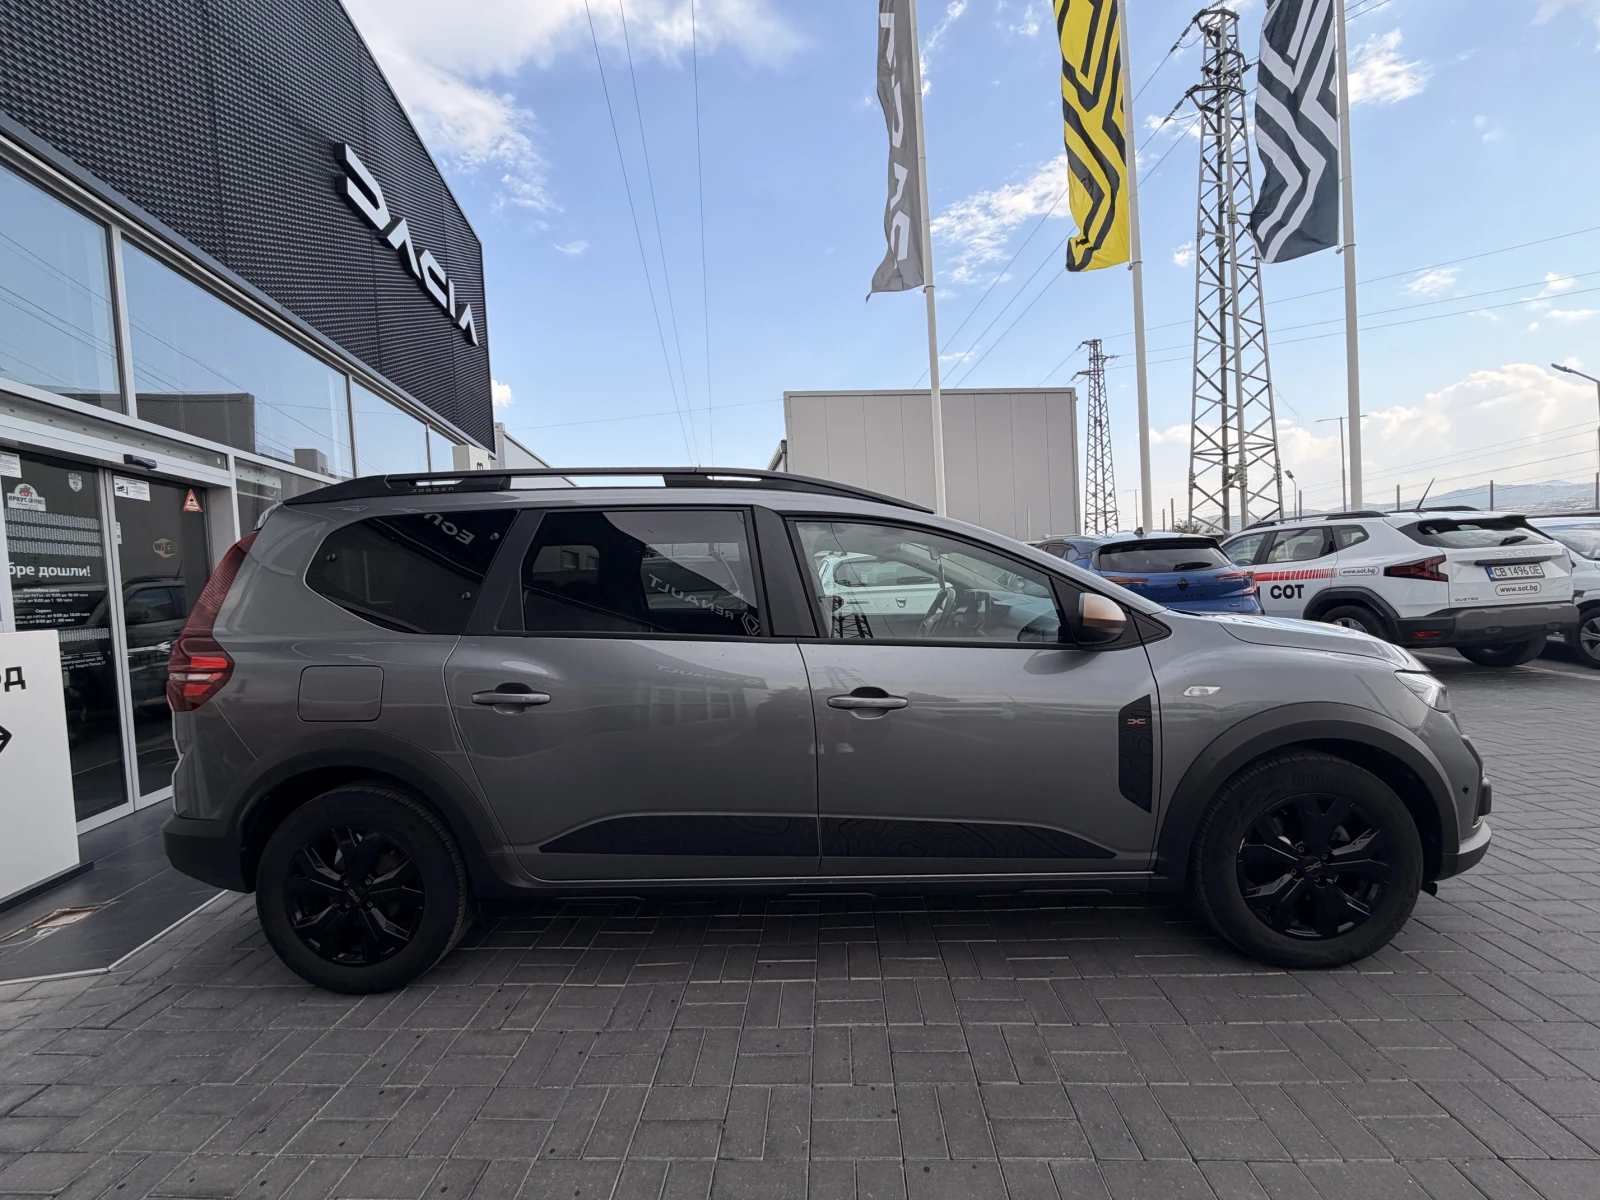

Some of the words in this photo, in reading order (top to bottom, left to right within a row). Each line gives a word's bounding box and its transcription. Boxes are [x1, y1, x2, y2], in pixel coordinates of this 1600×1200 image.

[333, 142, 479, 346] DACIA
[8, 562, 35, 578] бре
[38, 565, 91, 578] дошли!
[1493, 568, 1507, 578] CB
[1509, 566, 1528, 576] 1496
[1529, 565, 1542, 575] OE
[1500, 584, 1538, 593] www.sot.bg
